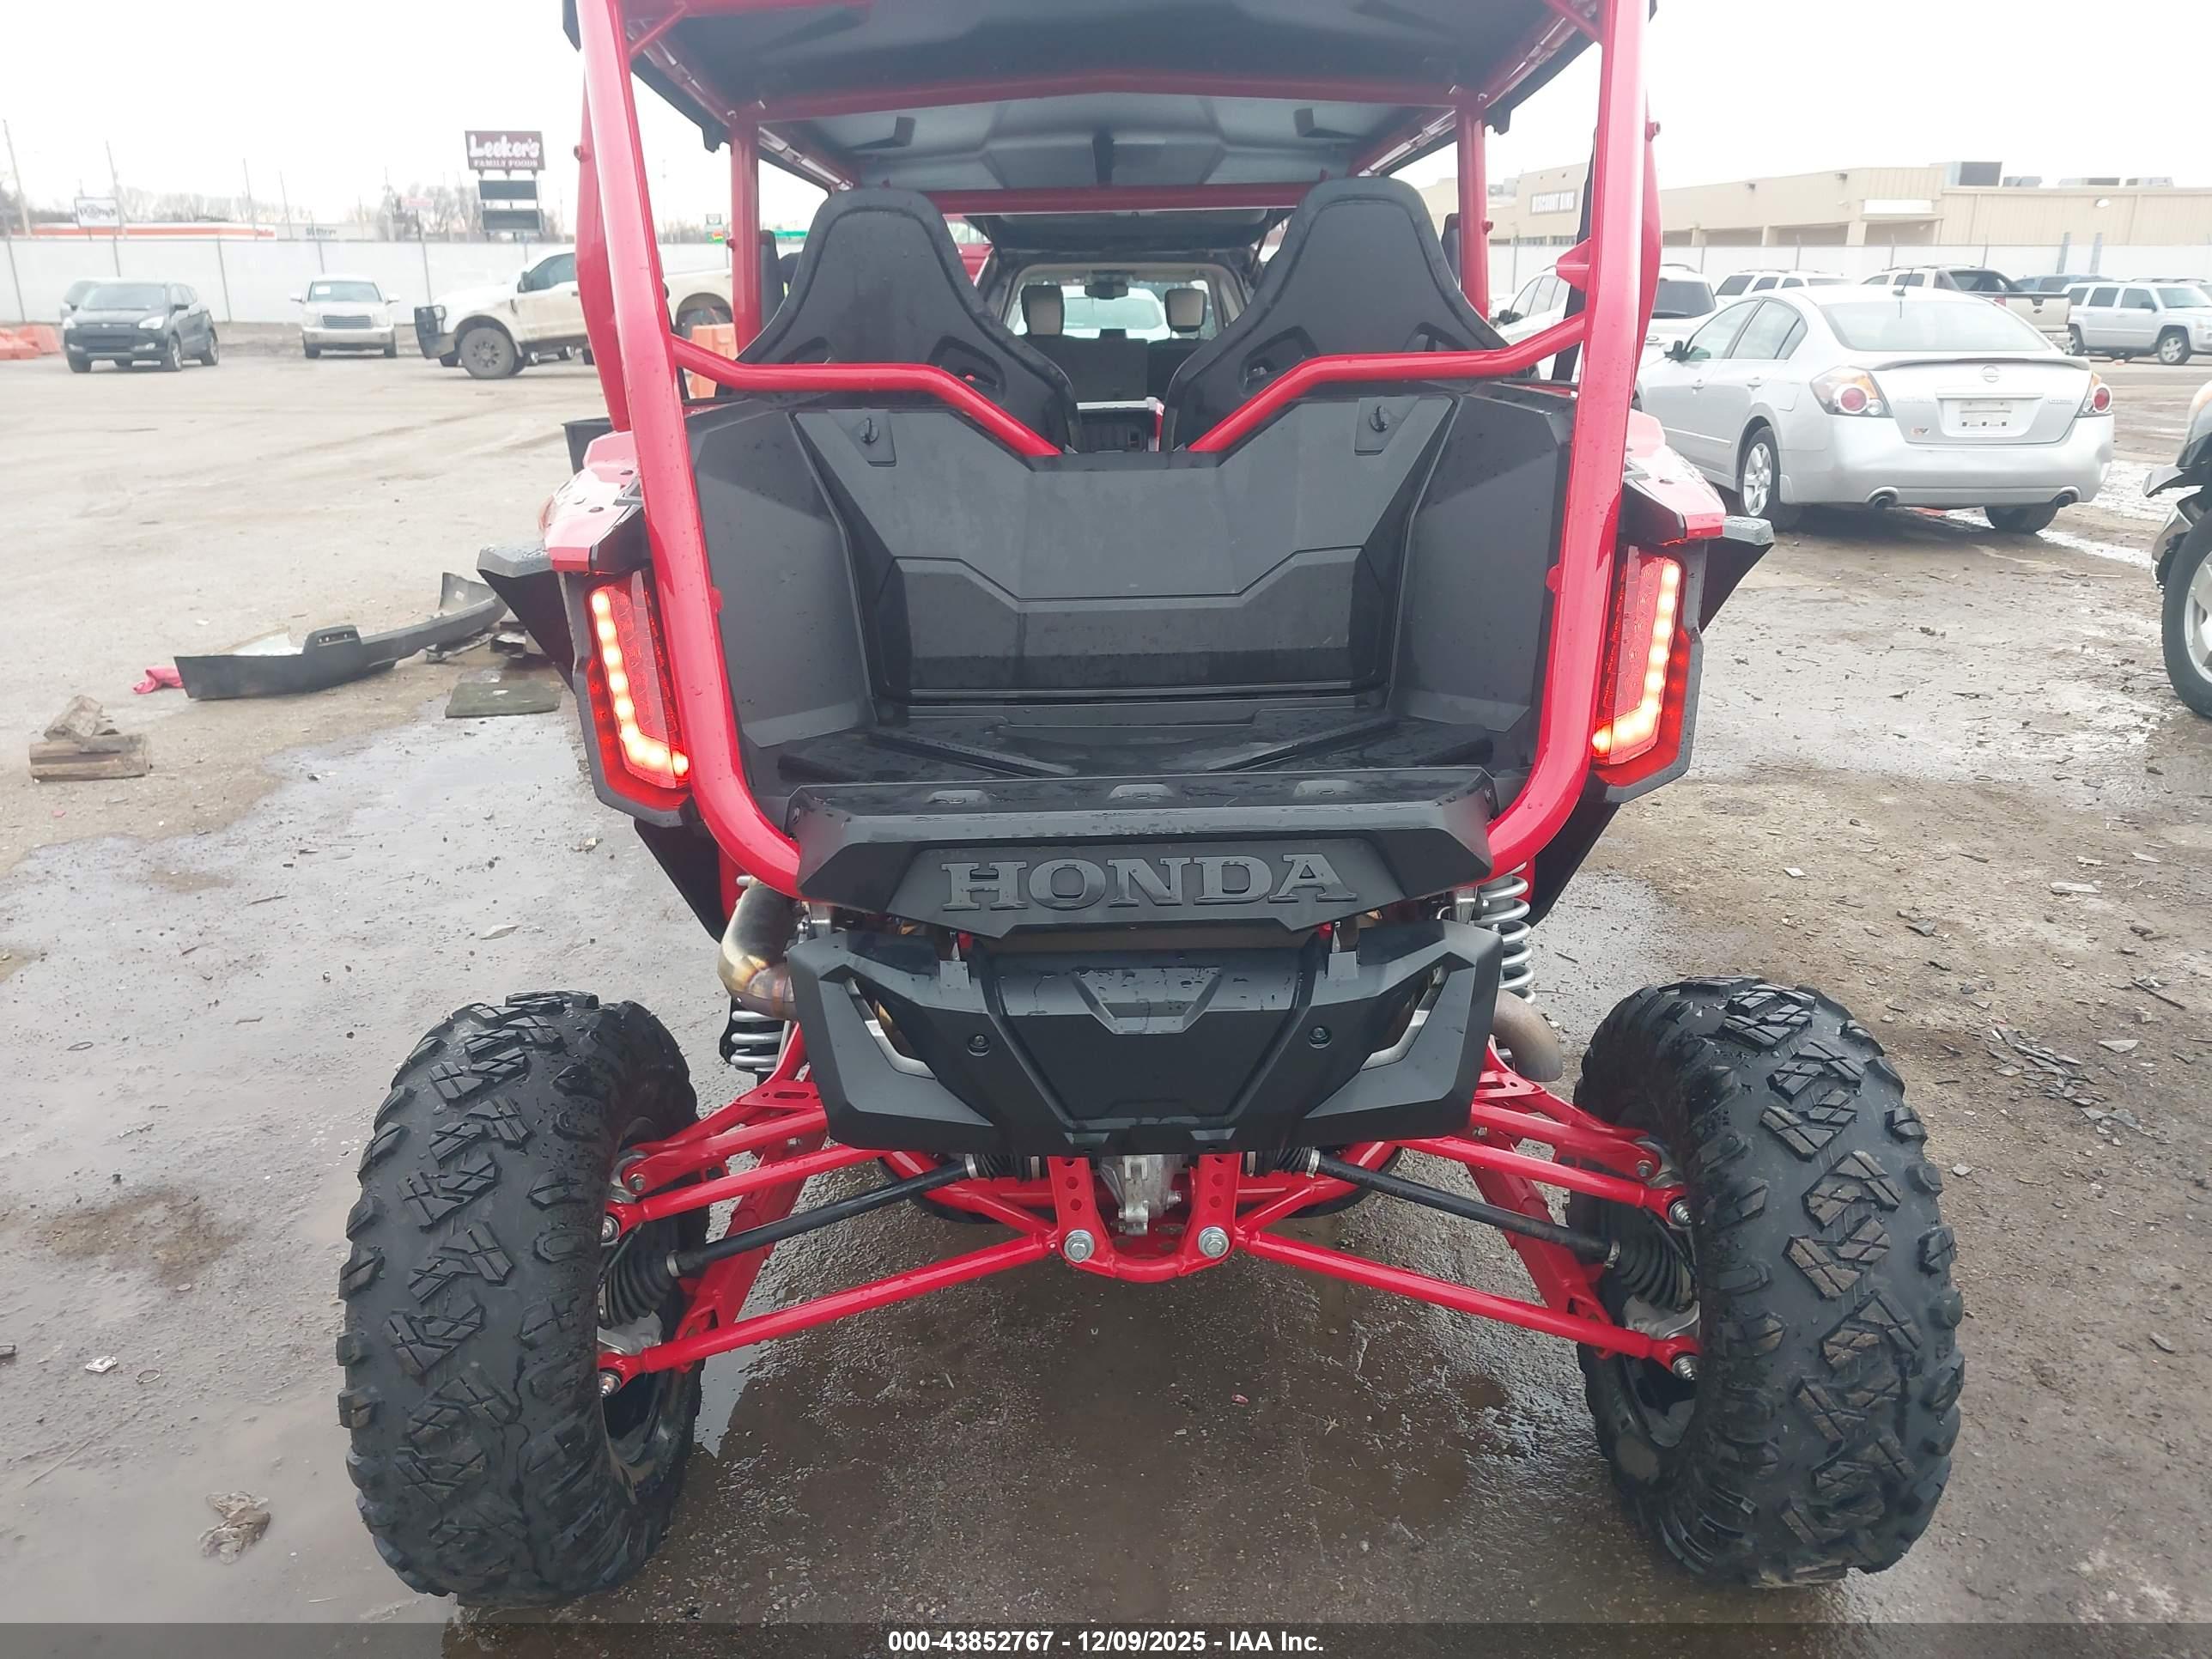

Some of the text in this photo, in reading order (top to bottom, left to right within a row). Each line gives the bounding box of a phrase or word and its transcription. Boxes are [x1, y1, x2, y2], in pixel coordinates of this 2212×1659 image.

[469, 134, 540, 159] Leeker's
[473, 159, 506, 167] FAMILY
[940, 853, 1358, 912] HONDA
